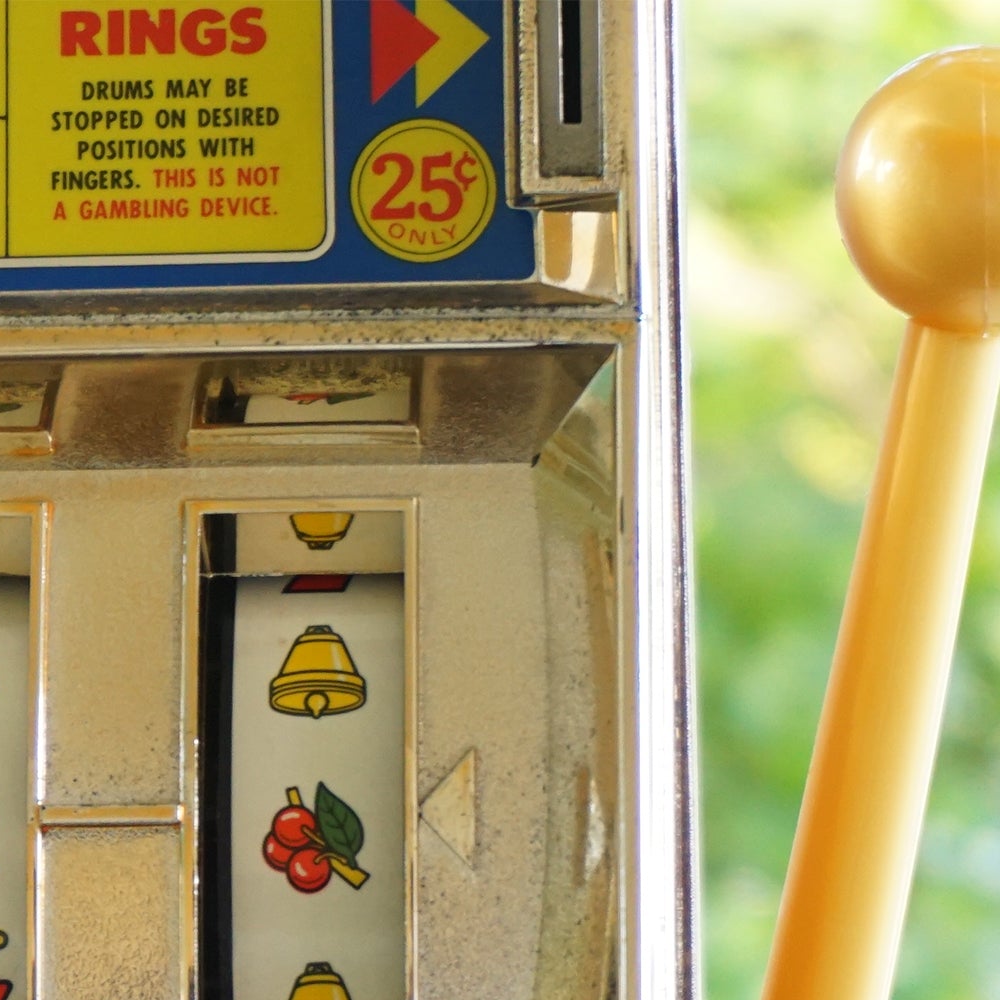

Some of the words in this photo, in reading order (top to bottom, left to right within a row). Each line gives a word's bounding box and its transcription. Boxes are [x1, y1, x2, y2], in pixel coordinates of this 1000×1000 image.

[60, 7, 268, 57] RINGS
[81, 79, 154, 101] DRUMS
[165, 78, 214, 99] MAY
[225, 77, 250, 98] BE
[51, 108, 144, 131] STOPPED
[155, 107, 187, 129] ON
[198, 106, 280, 128] DESIRED
[77, 137, 187, 160] POSITIONS
[198, 136, 255, 158] WITH
[50, 168, 141, 191] FINGERS.
[153, 167, 197, 189] THIS
[208, 166, 227, 188] IS
[237, 165, 281, 187] NOT
[53, 198, 68, 221] A
[78, 197, 190, 220] GAMBLING
[200, 195, 279, 218] DEVICE.
[387, 220, 460, 247] ONLY
